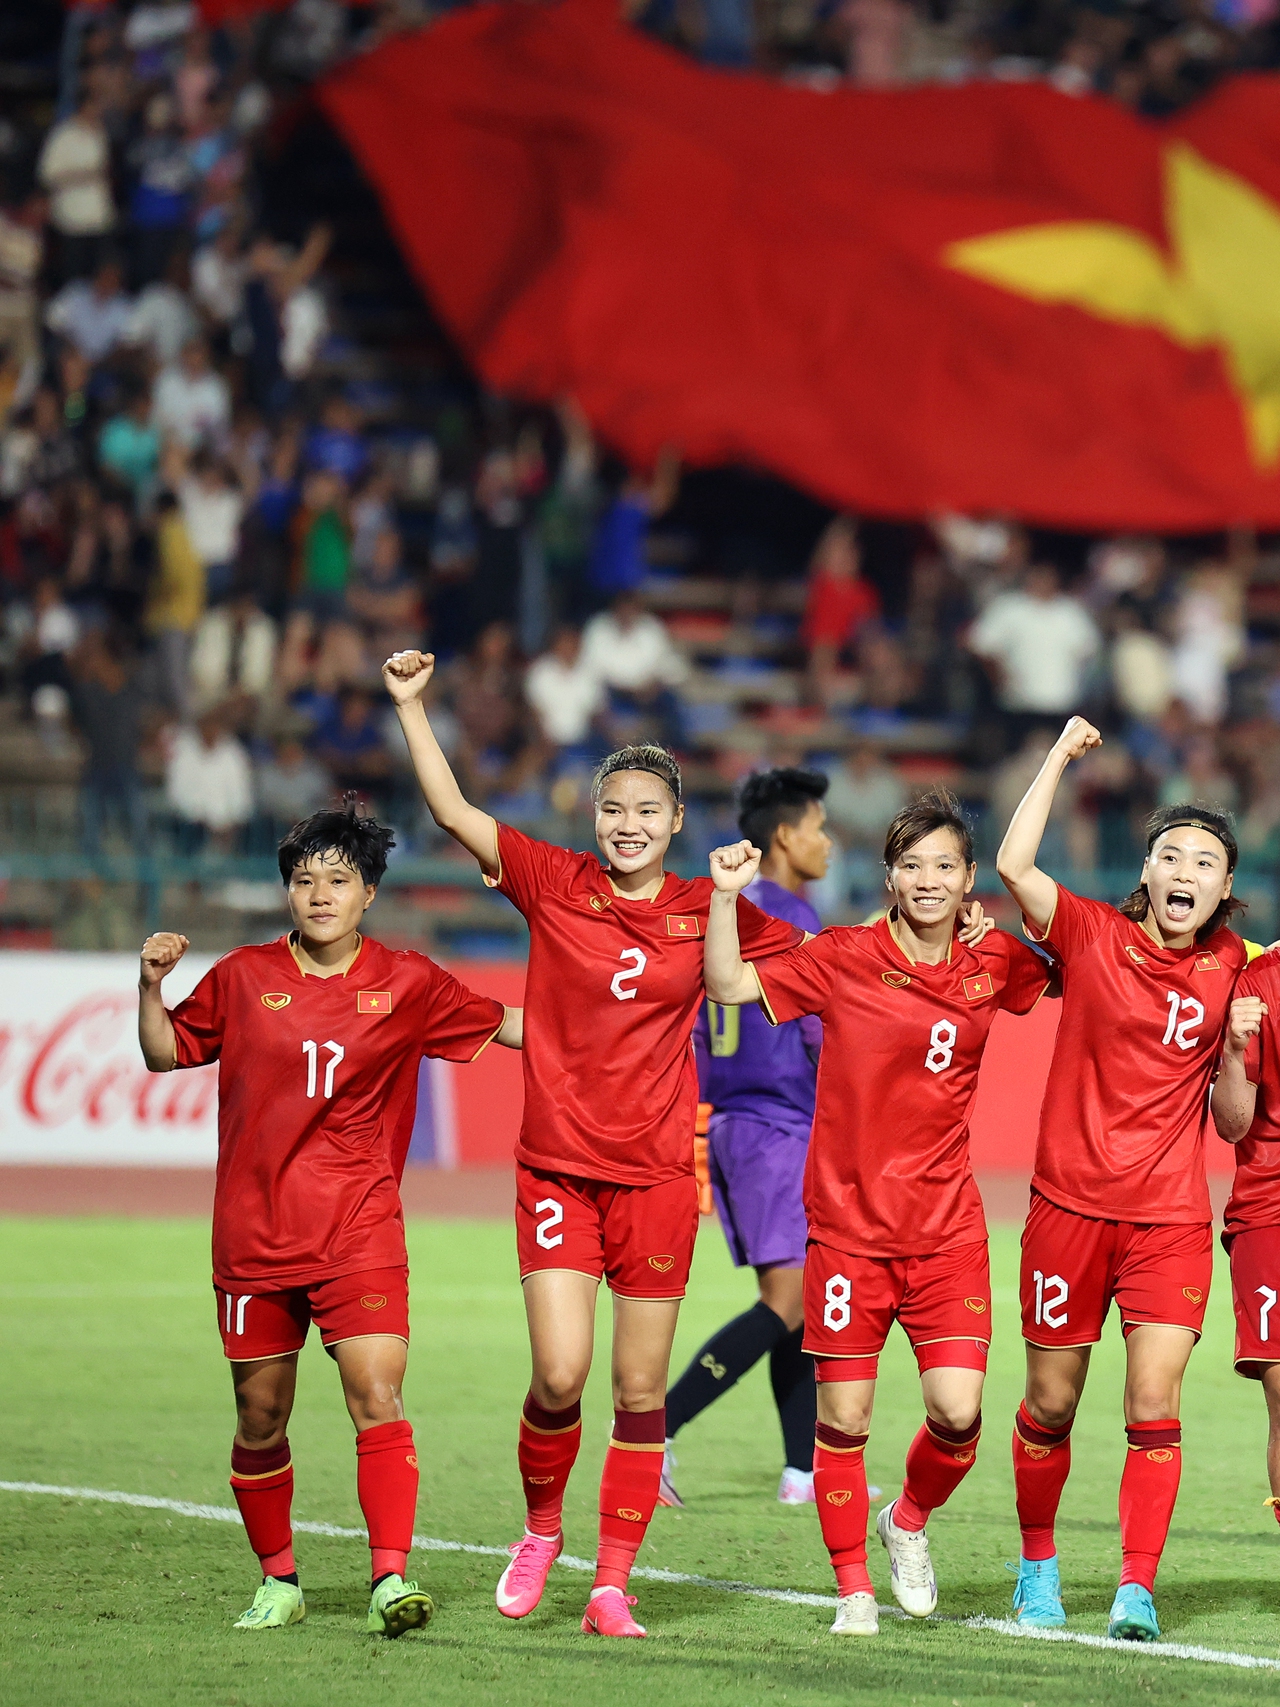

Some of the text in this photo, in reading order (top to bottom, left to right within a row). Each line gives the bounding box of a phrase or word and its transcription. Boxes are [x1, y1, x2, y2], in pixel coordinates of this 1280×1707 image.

[609, 947, 648, 1001] 2
[924, 1018, 957, 1075] 8
[1161, 990, 1205, 1051] 12
[302, 1039, 346, 1099] 17
[535, 1197, 564, 1250] 2
[823, 1273, 853, 1333] 8
[1033, 1269, 1070, 1329] 12
[1254, 1284, 1277, 1342] 7
